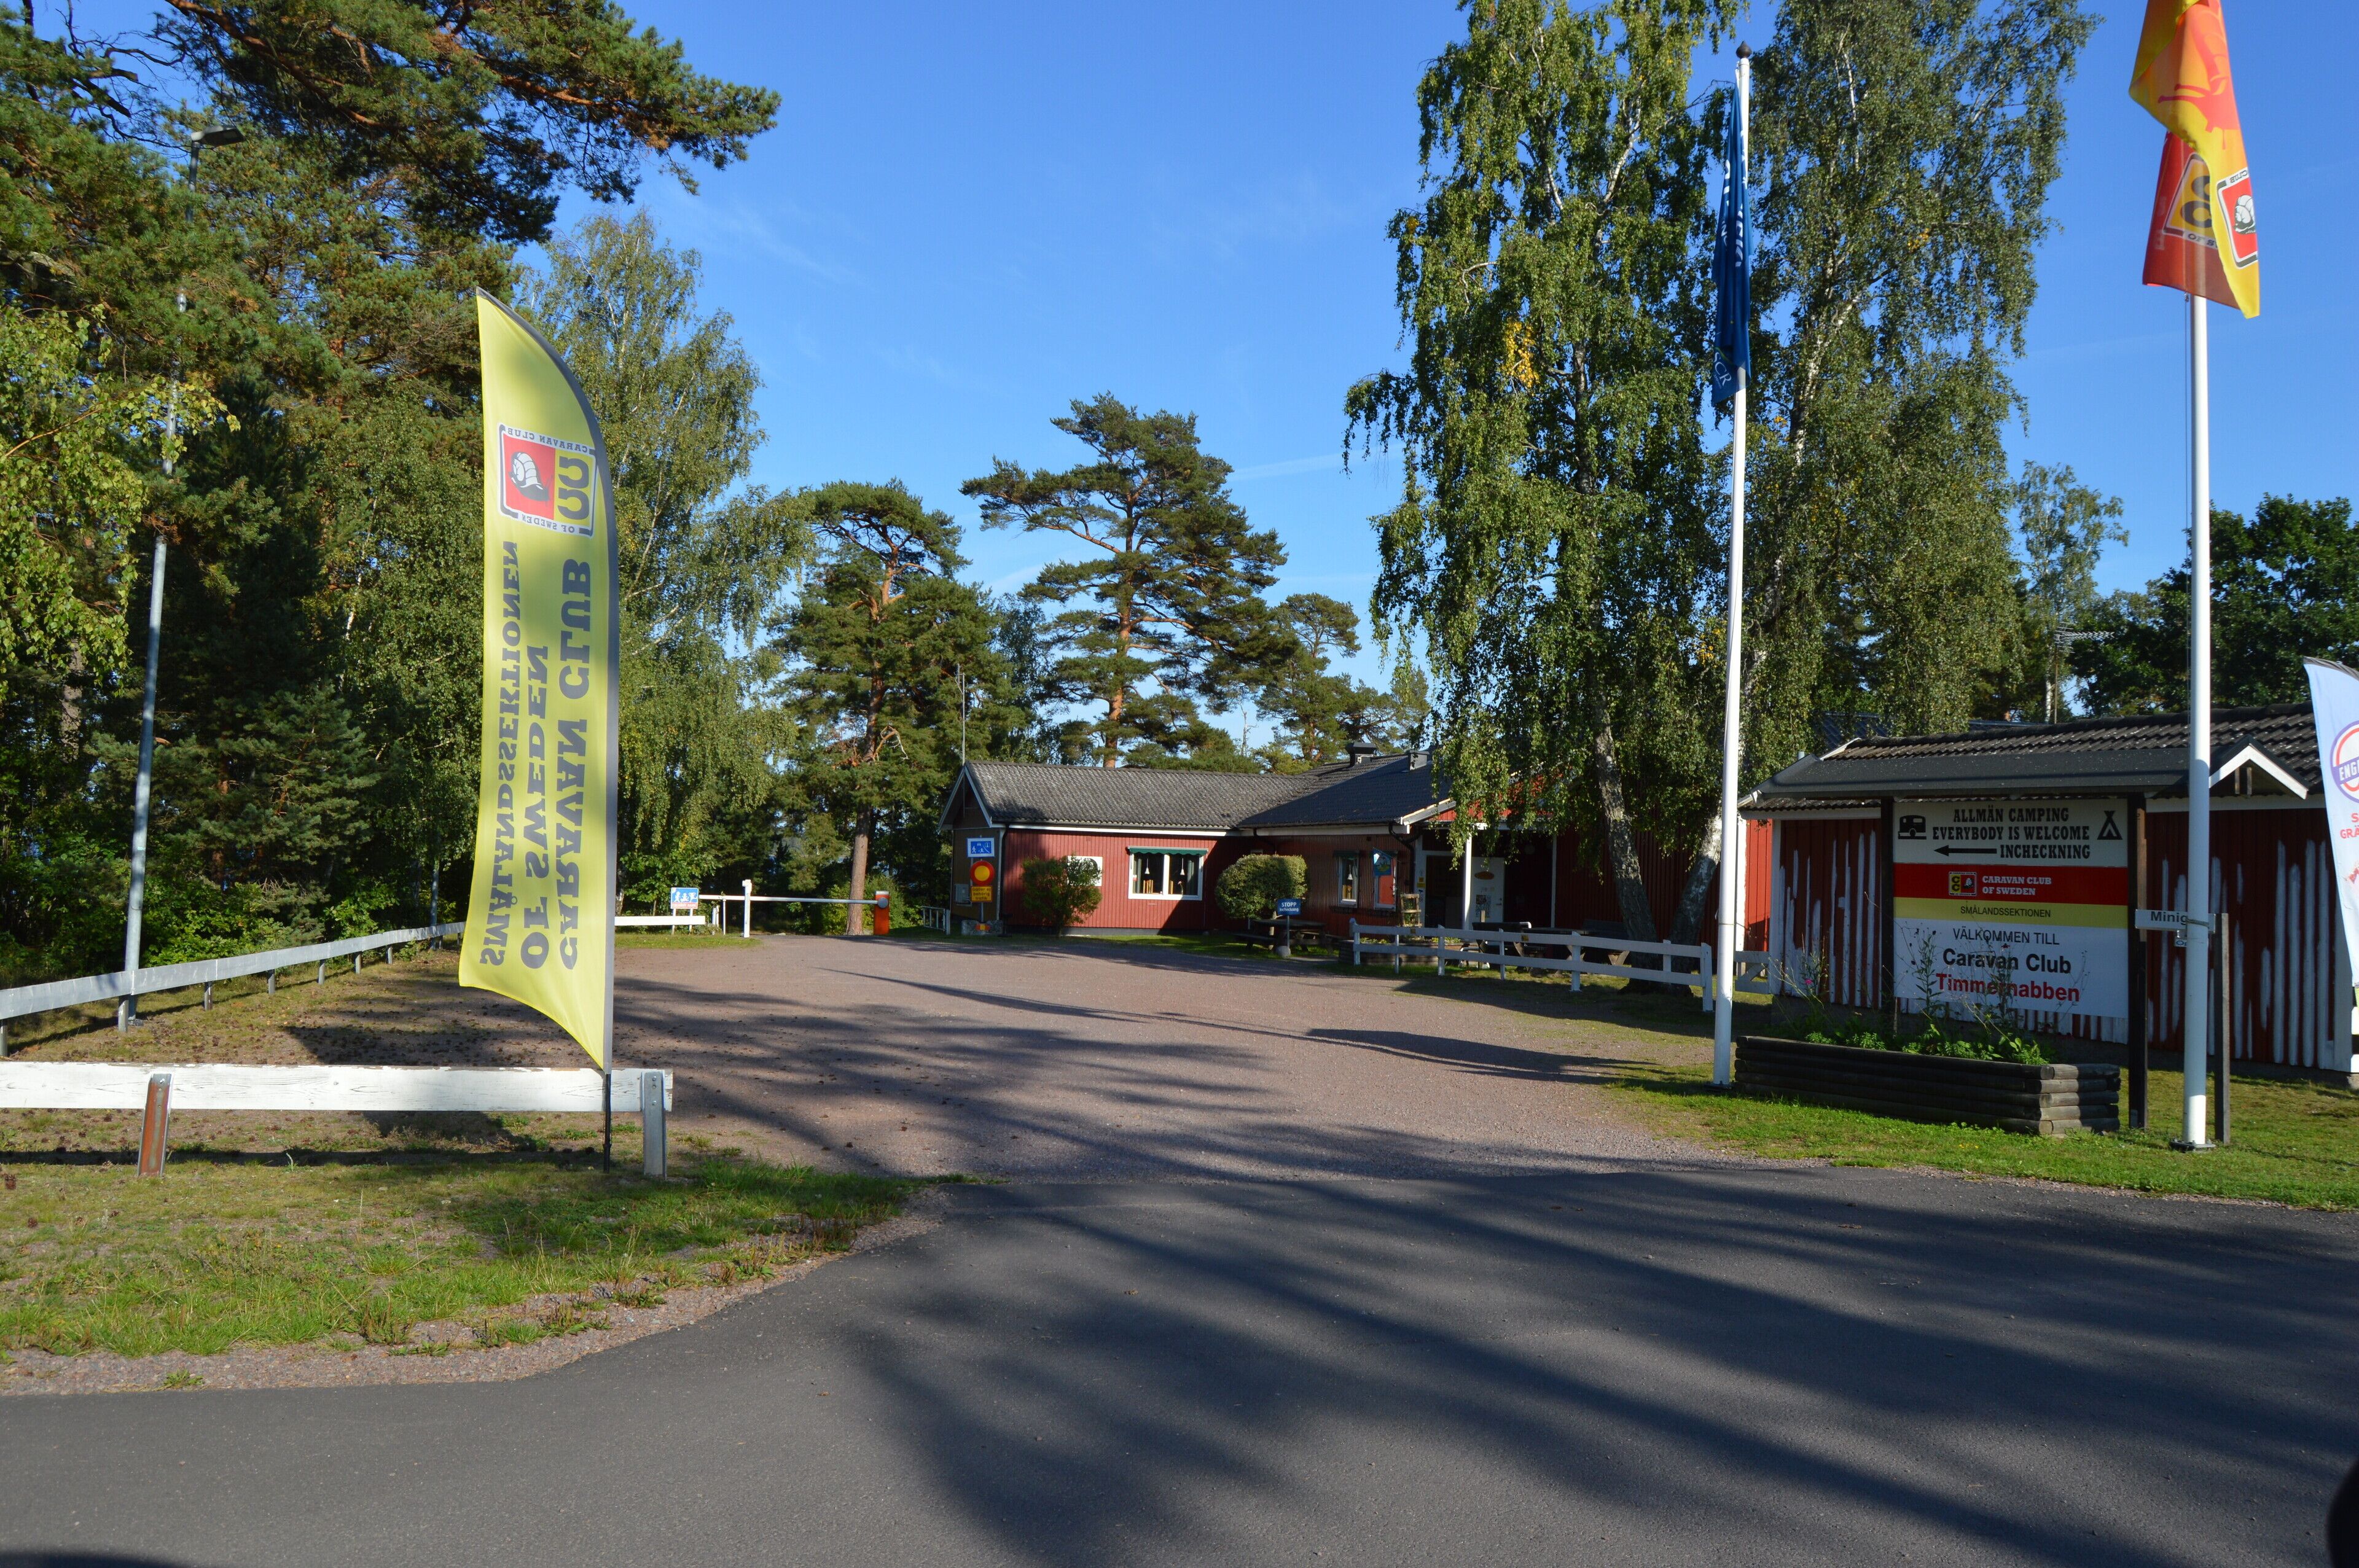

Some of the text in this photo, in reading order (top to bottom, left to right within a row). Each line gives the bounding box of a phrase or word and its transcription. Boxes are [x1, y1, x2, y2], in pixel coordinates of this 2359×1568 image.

[1954, 805, 2069, 822] ALLMÄN CAMPING
[1933, 826, 2090, 840] EVERYBODY IS WELCOME
[2000, 844, 2091, 859] INCHECKNING
[1982, 875, 2025, 884] CARAVAN
[1997, 887, 2036, 895] SWEDEN
[1960, 905, 2051, 918] SMÅLANDSSEKTIONEN
[1952, 926, 2060, 945] VÄLKOMMEN TILL
[1942, 948, 2071, 973] Caravan Club
